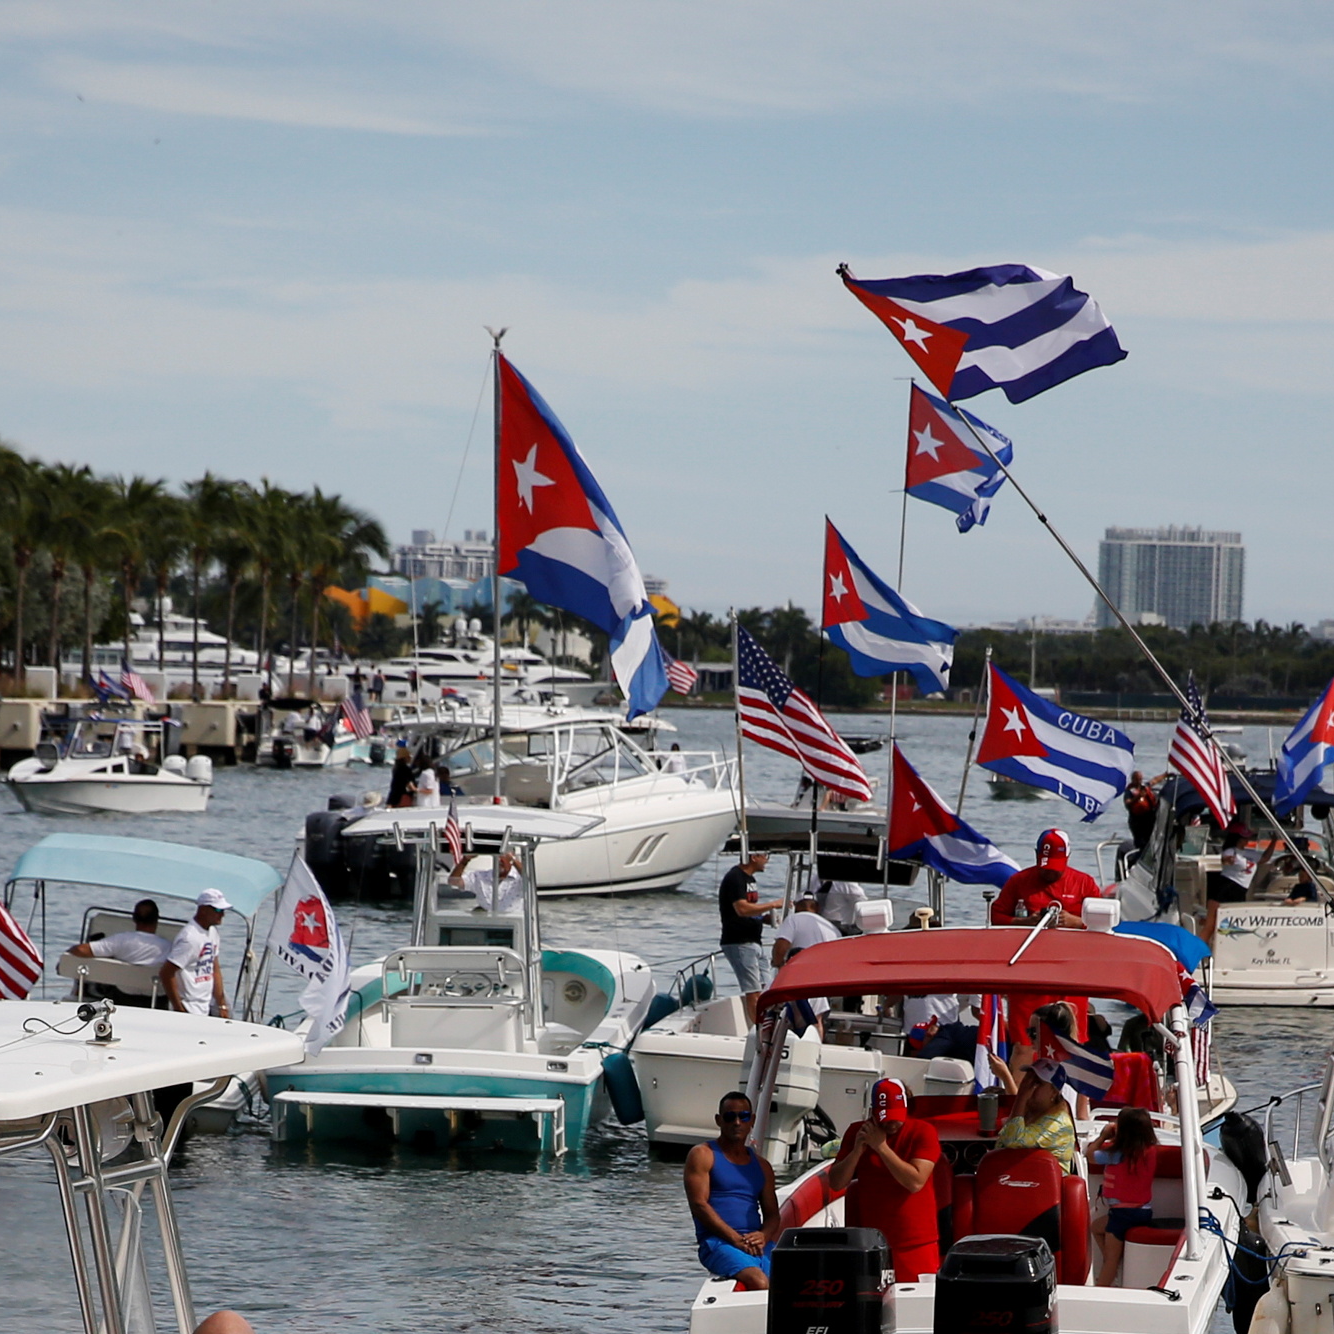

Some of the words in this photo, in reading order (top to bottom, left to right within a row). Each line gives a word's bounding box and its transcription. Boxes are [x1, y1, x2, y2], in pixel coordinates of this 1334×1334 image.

[1058, 711, 1116, 744] CUBA
[1249, 915, 1324, 927] WHITTECOMB
[278, 945, 304, 974] VIVA
[878, 1092, 887, 1122] CUBA
[799, 1280, 845, 1296] 250
